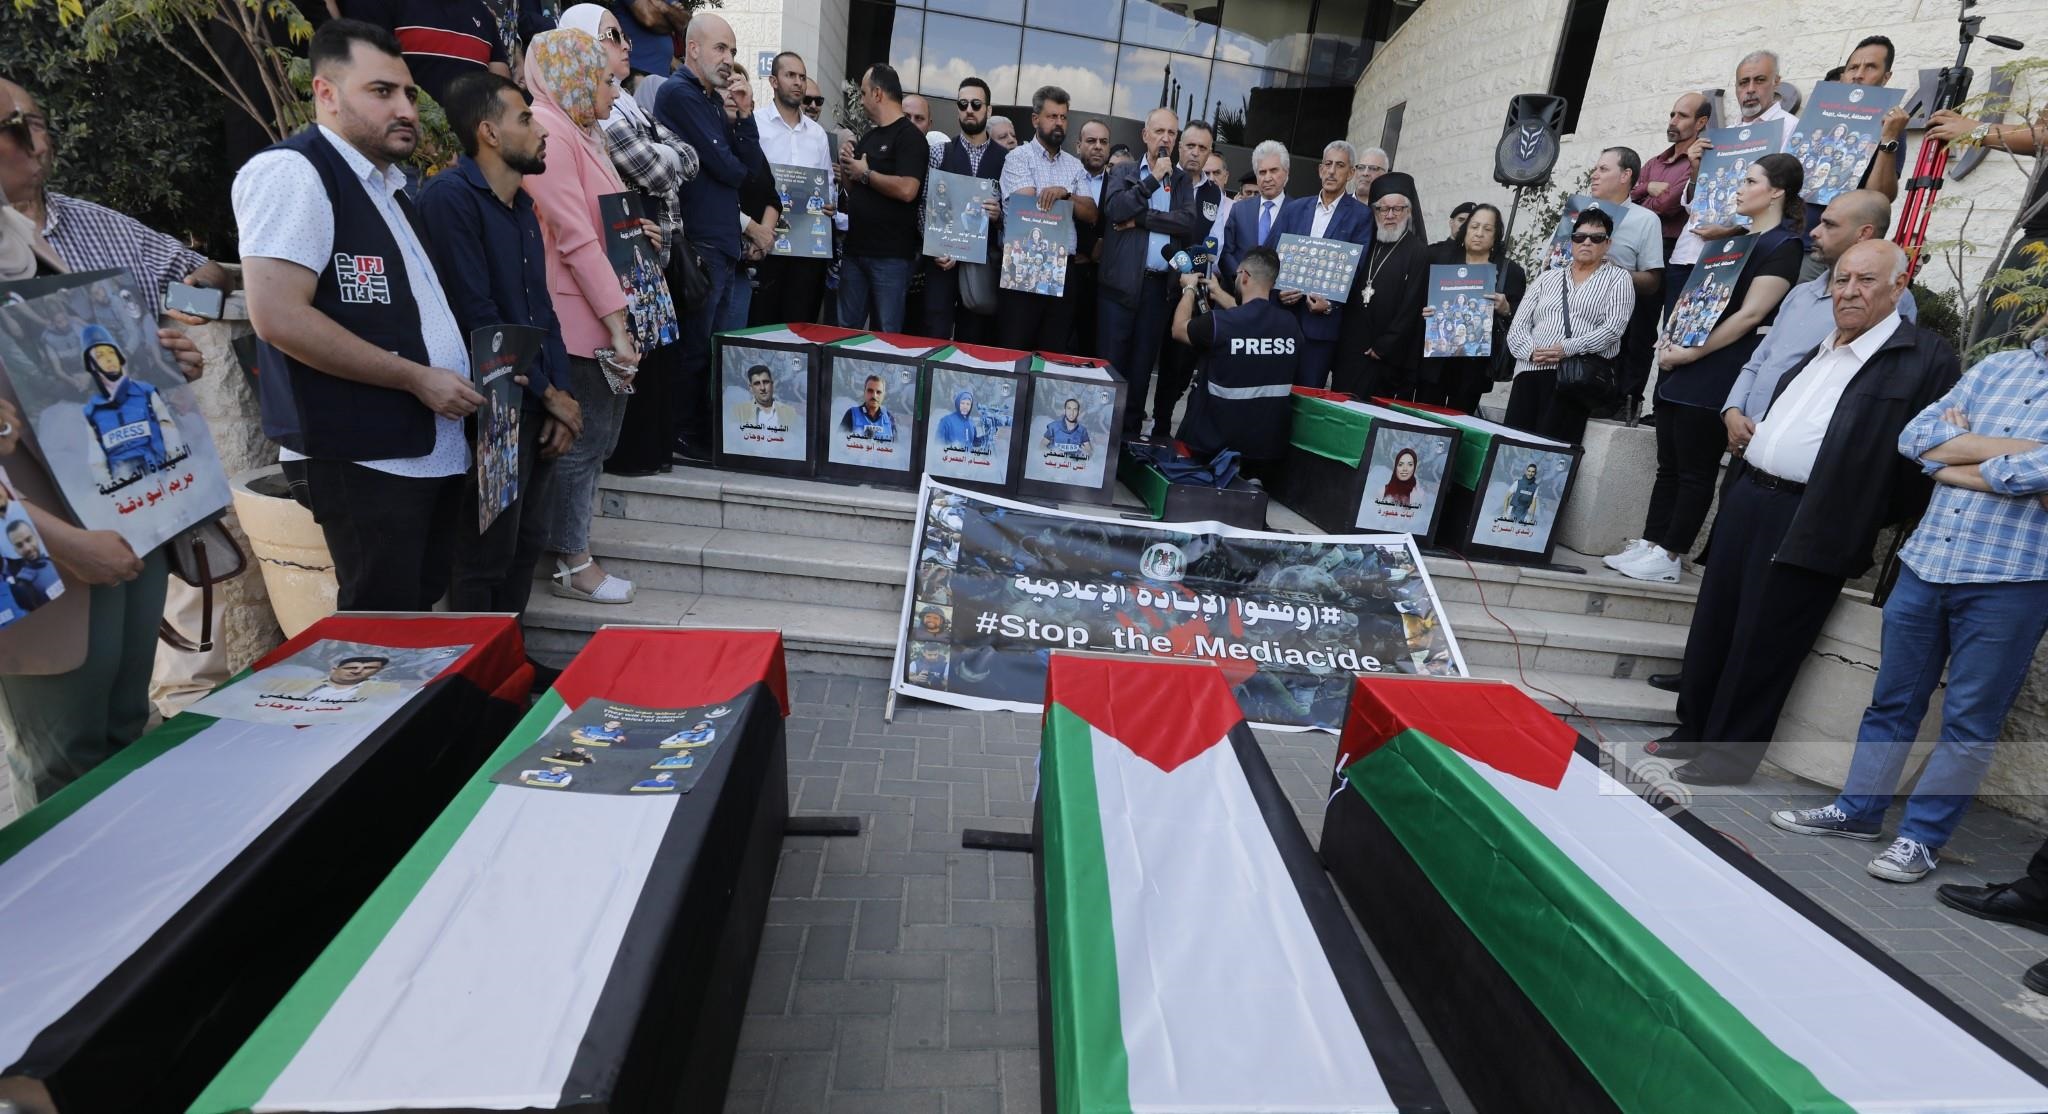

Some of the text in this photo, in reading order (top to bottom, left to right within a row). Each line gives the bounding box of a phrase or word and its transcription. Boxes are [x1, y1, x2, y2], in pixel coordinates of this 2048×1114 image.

[760, 57, 774, 72] 15
[354, 255, 385, 274] IFJ
[1230, 337, 1296, 356] PRESS
[108, 423, 146, 445] PRESS
[168, 472, 195, 497] مريم
[115, 496, 145, 515] دقة
[1014, 573, 1127, 613] الإعلامية
